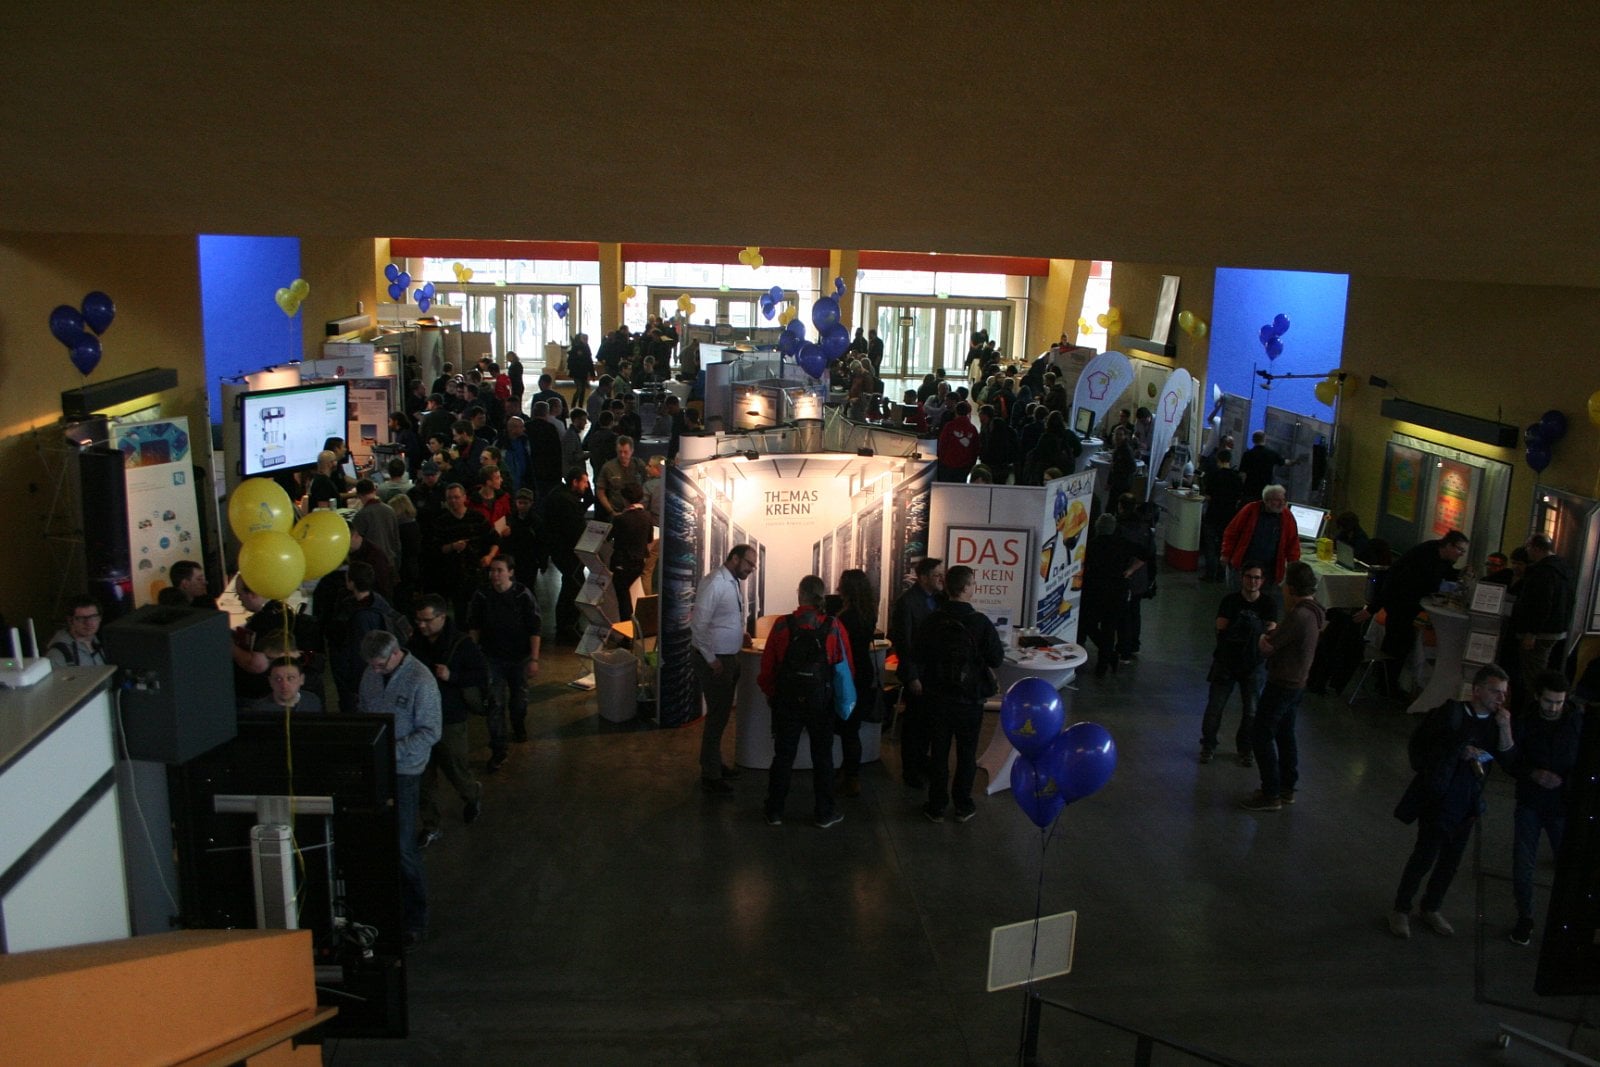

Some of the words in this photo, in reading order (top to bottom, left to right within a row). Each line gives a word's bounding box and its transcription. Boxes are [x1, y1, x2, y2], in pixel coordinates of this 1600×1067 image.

[766, 503, 811, 515] KRENN
[956, 537, 1019, 566] DAS
[982, 569, 1014, 581] KEIN
[974, 584, 1008, 595] HTEST
